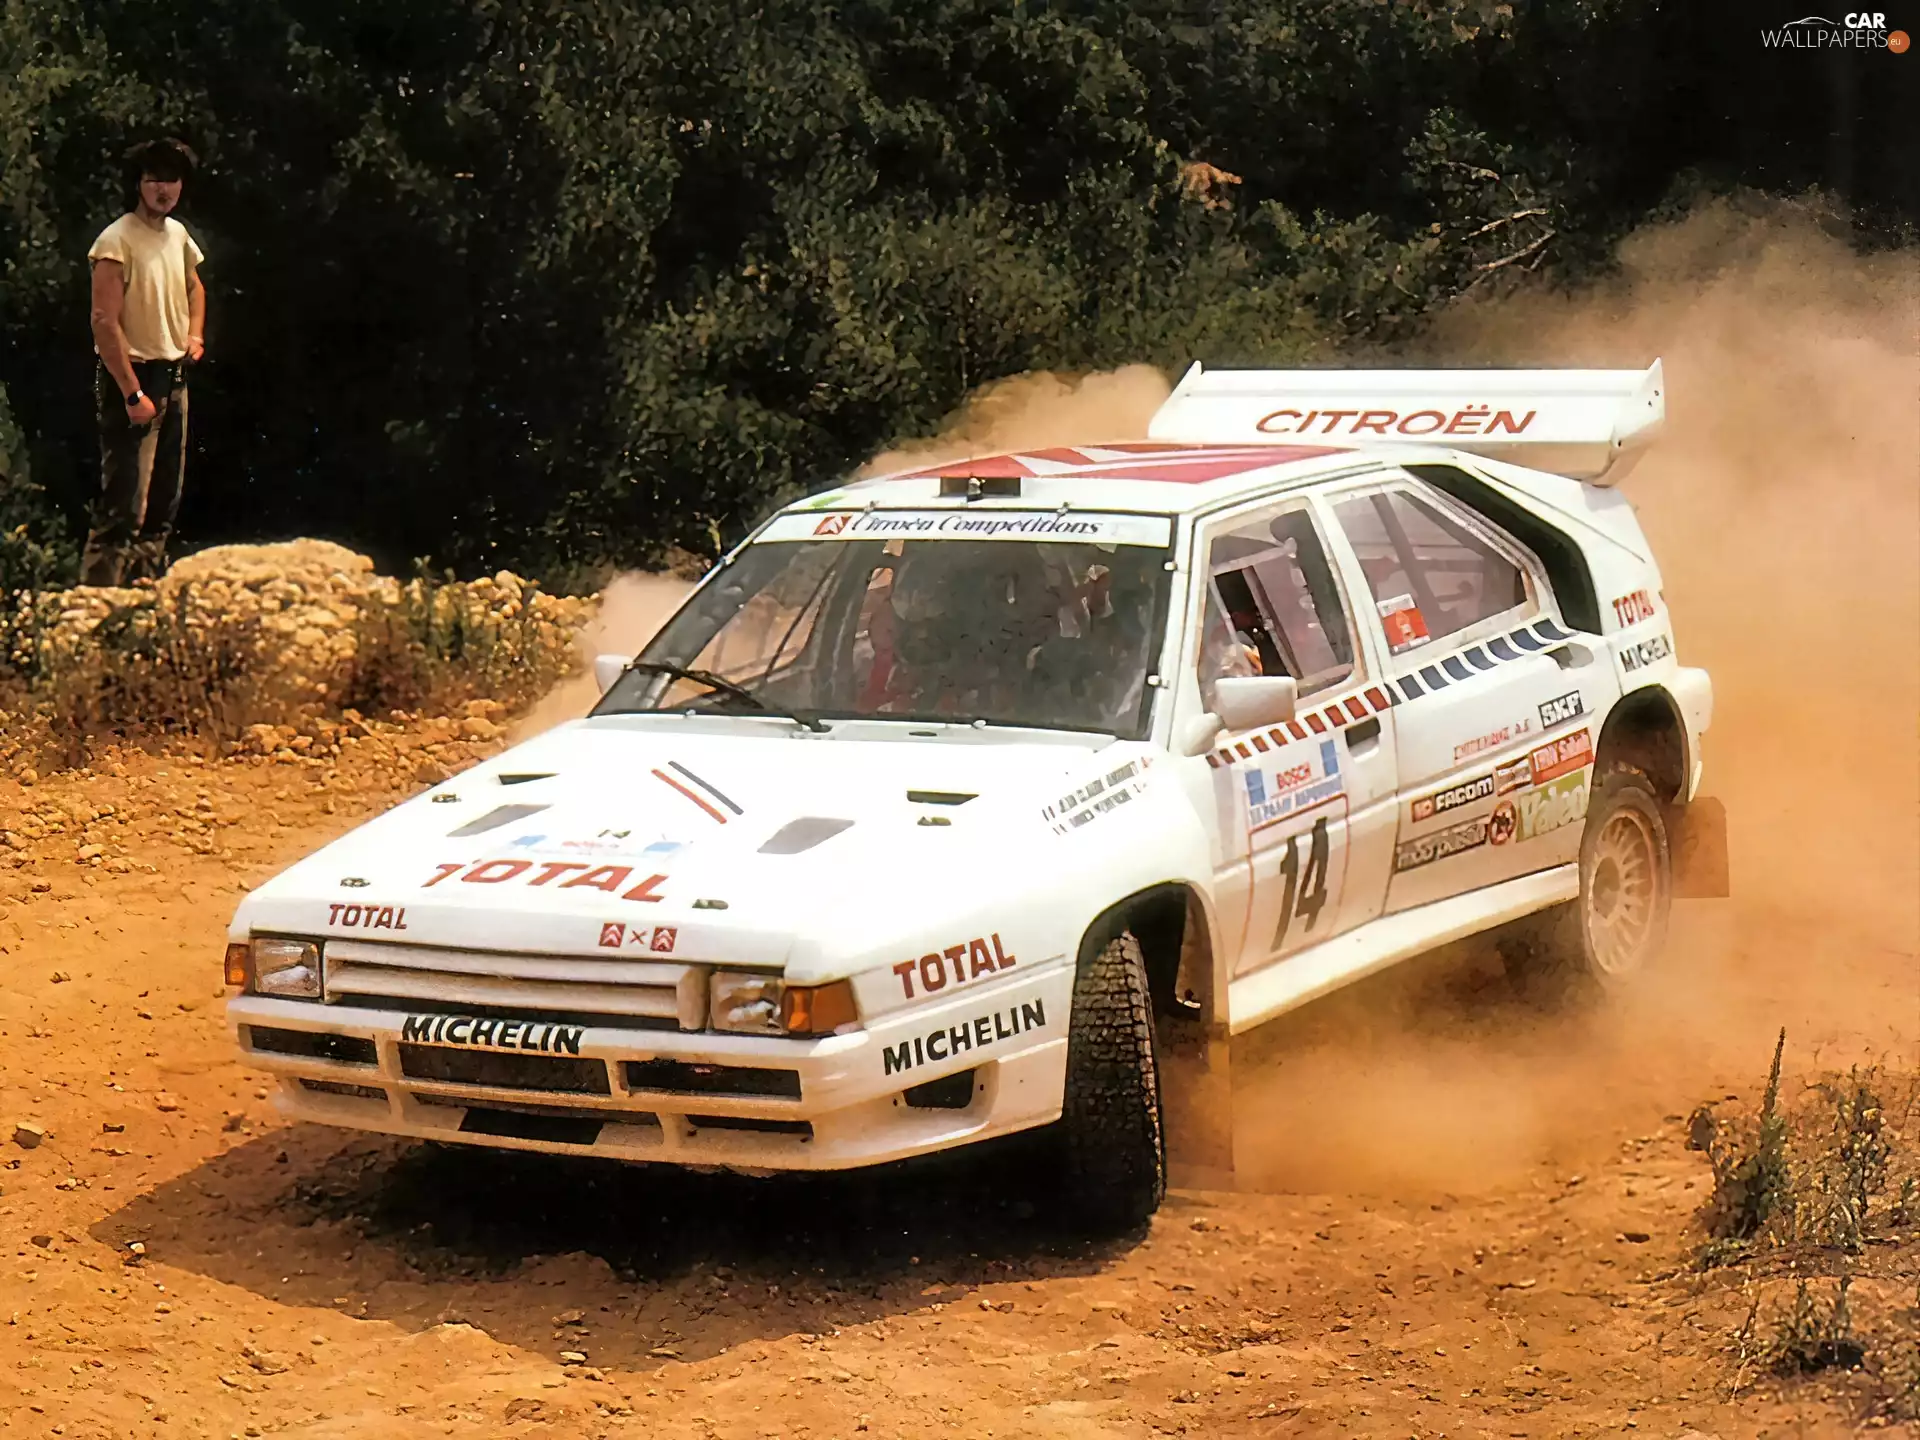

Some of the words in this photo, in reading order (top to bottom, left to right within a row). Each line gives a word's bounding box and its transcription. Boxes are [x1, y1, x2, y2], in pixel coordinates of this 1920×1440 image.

[1255, 403, 1537, 435] CITROËN
[1435, 776, 1495, 811] FACOM
[420, 859, 669, 903] TOTAL
[1270, 816, 1330, 953] 14
[328, 903, 408, 930] TOTAL
[892, 932, 1017, 1000] TOTAL
[402, 1014, 584, 1056] MICHELIN
[882, 997, 1047, 1076] MICHELIN
